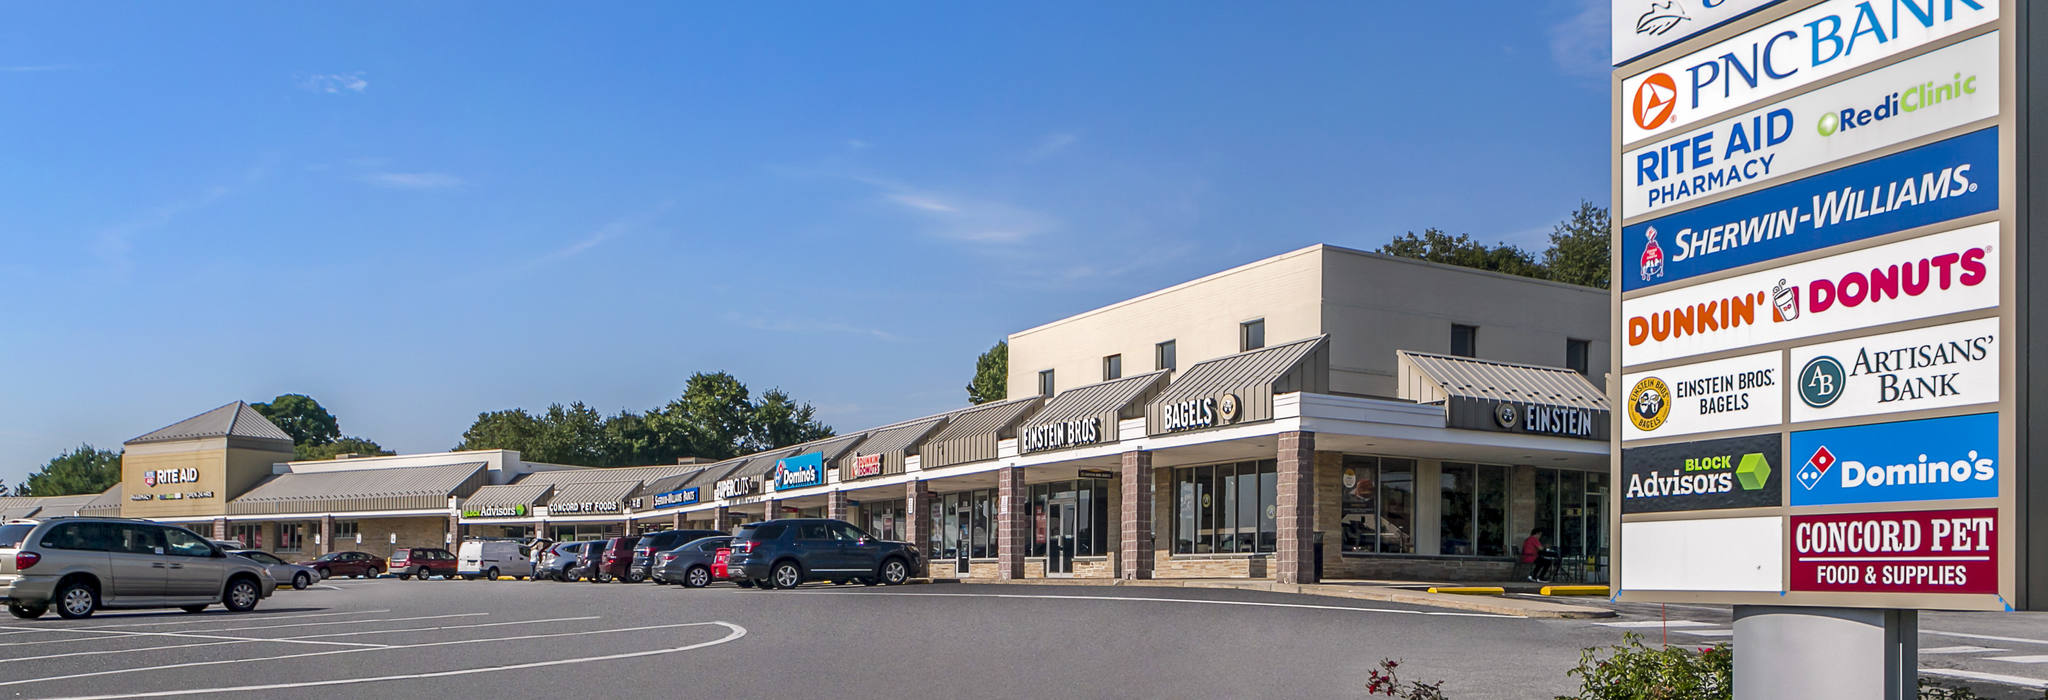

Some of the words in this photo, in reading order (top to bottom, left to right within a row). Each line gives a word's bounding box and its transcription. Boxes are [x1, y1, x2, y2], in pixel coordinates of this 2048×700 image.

[1685, 30, 1800, 110] PNC
[1840, 72, 1977, 133] RediClinic
[1636, 131, 1714, 187] RITE
[1724, 107, 1794, 160] AID
[1648, 154, 1775, 208] PHARMACY
[1629, 290, 1765, 347] DUNKIN'
[1809, 247, 1988, 314] DONUTS
[1850, 335, 1995, 377] ARTISANS'
[1631, 379, 1655, 402] EINSTEIN
[1676, 374, 1735, 399] EINSTEIN
[1808, 365, 1834, 396] AB
[1879, 372, 1960, 403] BANK
[1164, 397, 1212, 430] BAGELS
[1699, 392, 1749, 416] BAGELS
[1023, 422, 1064, 451] EINSTEIN
[1067, 417, 1097, 444] BROS
[1527, 405, 1592, 435] EINSTEIN
[1638, 416, 1661, 429] BAGELS
[157, 469, 179, 485] RITE
[180, 467, 198, 483] AID
[783, 464, 816, 485] Domino's
[859, 463, 879, 476] DONUTS
[1685, 455, 1731, 472] BLOCK
[1841, 450, 1995, 488] Domino's
[1626, 468, 1733, 499] Advisors
[480, 505, 516, 517] Advisors
[549, 502, 579, 513] CONCORD
[580, 502, 593, 512] PET
[594, 501, 617, 511] FOODS
[1795, 519, 1921, 554] CONCORD
[1931, 517, 1994, 552] PET
[1817, 565, 1861, 584] FOOD
[1864, 566, 1876, 584] &
[1882, 565, 1967, 585] SUPPLIES
